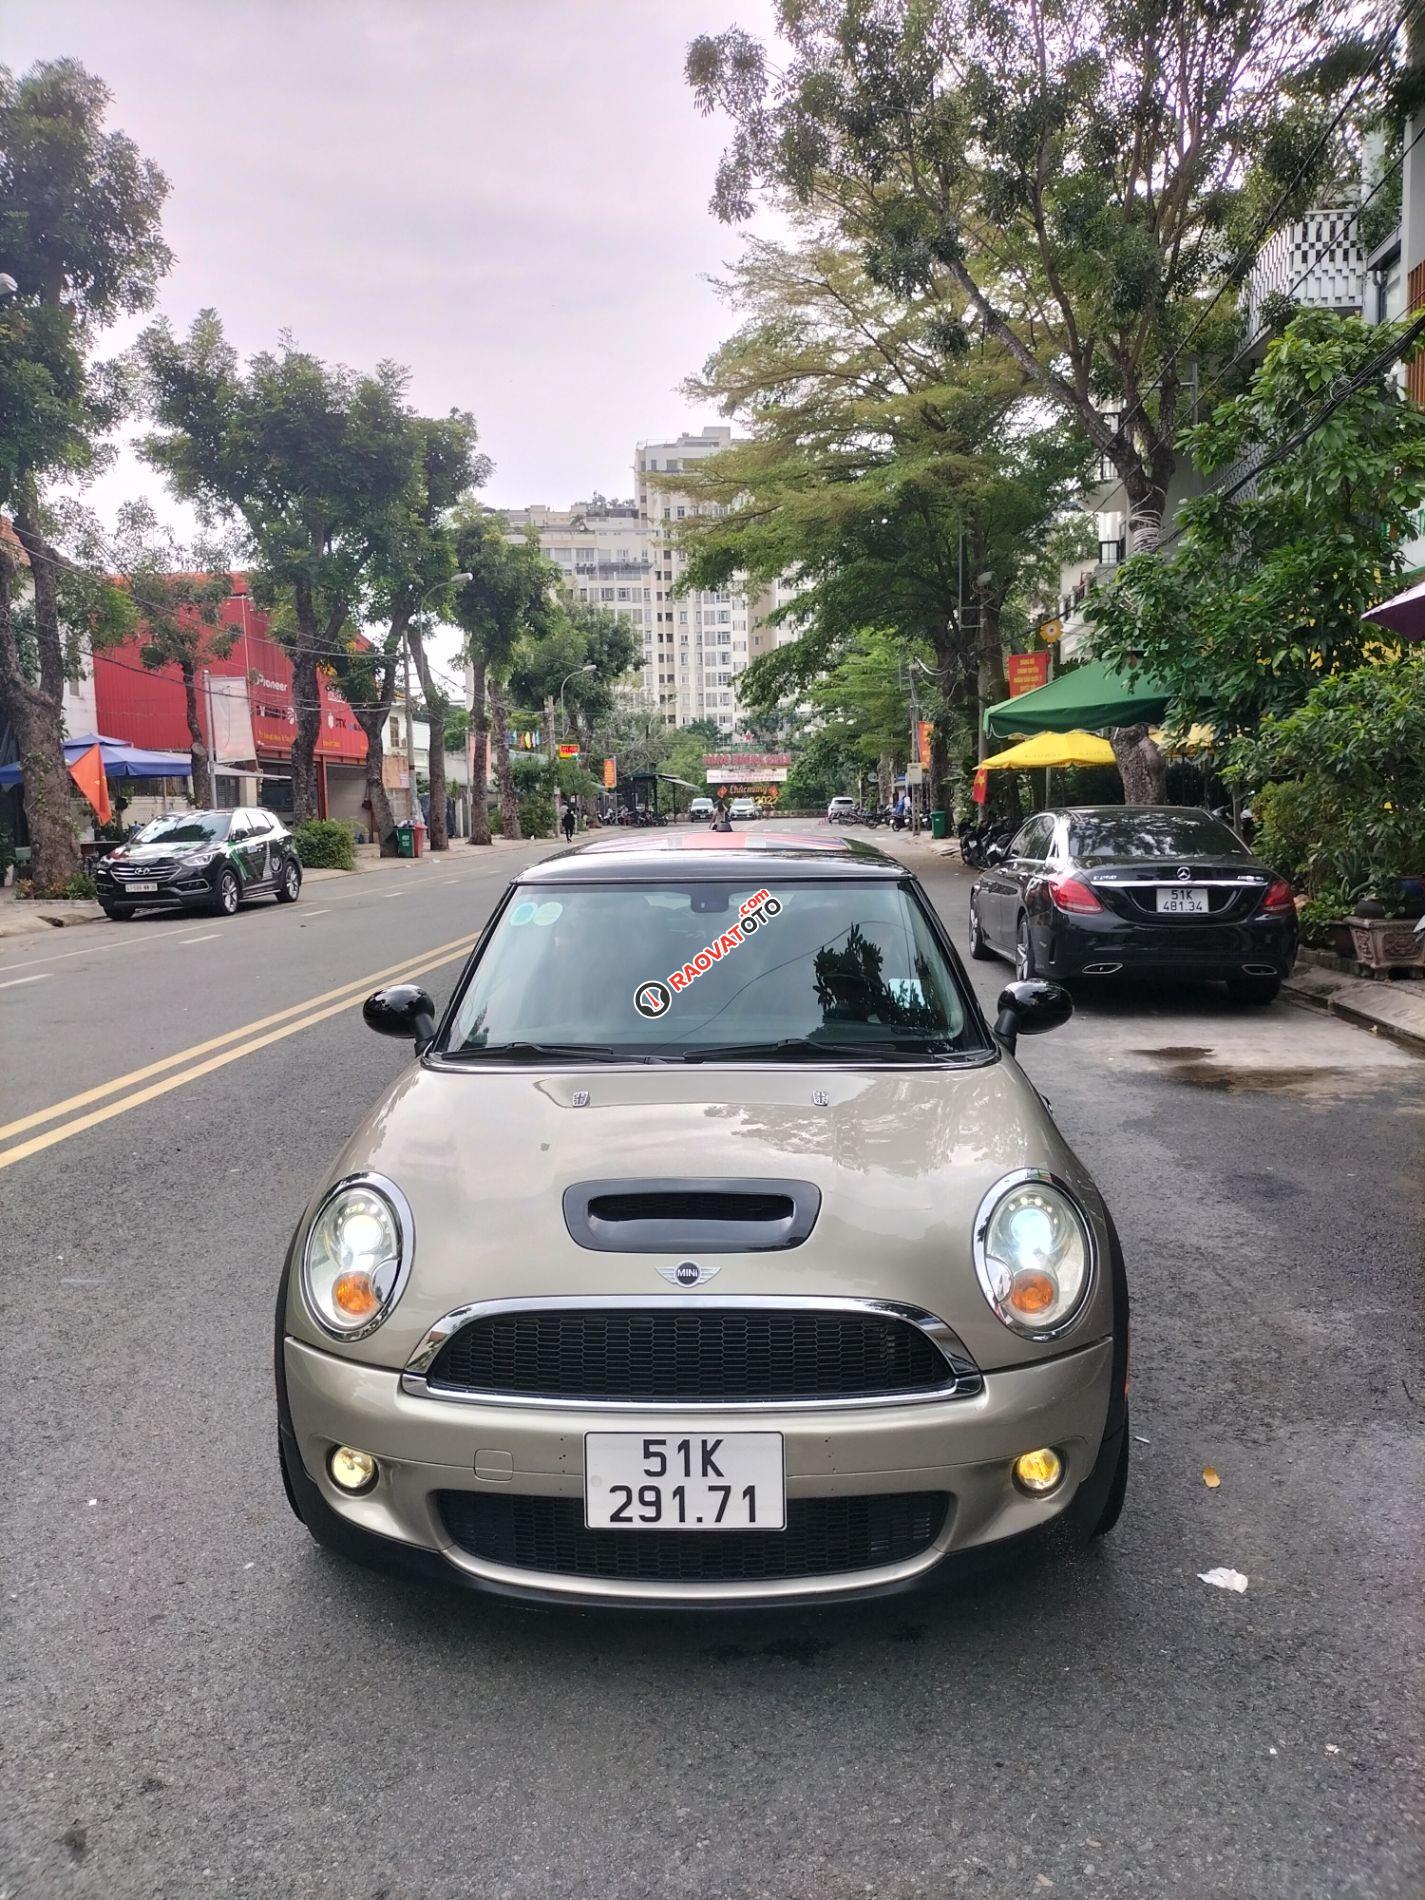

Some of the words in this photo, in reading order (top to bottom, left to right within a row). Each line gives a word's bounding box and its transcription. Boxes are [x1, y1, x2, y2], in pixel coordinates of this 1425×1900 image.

[255, 673, 288, 692] Pioneer
[1171, 889, 1193, 900] 51K
[1163, 901, 1203, 911] 481.34
[677, 1268, 698, 1277] MINI
[643, 1438, 725, 1477] 51K
[609, 1485, 756, 1523] 291.71
